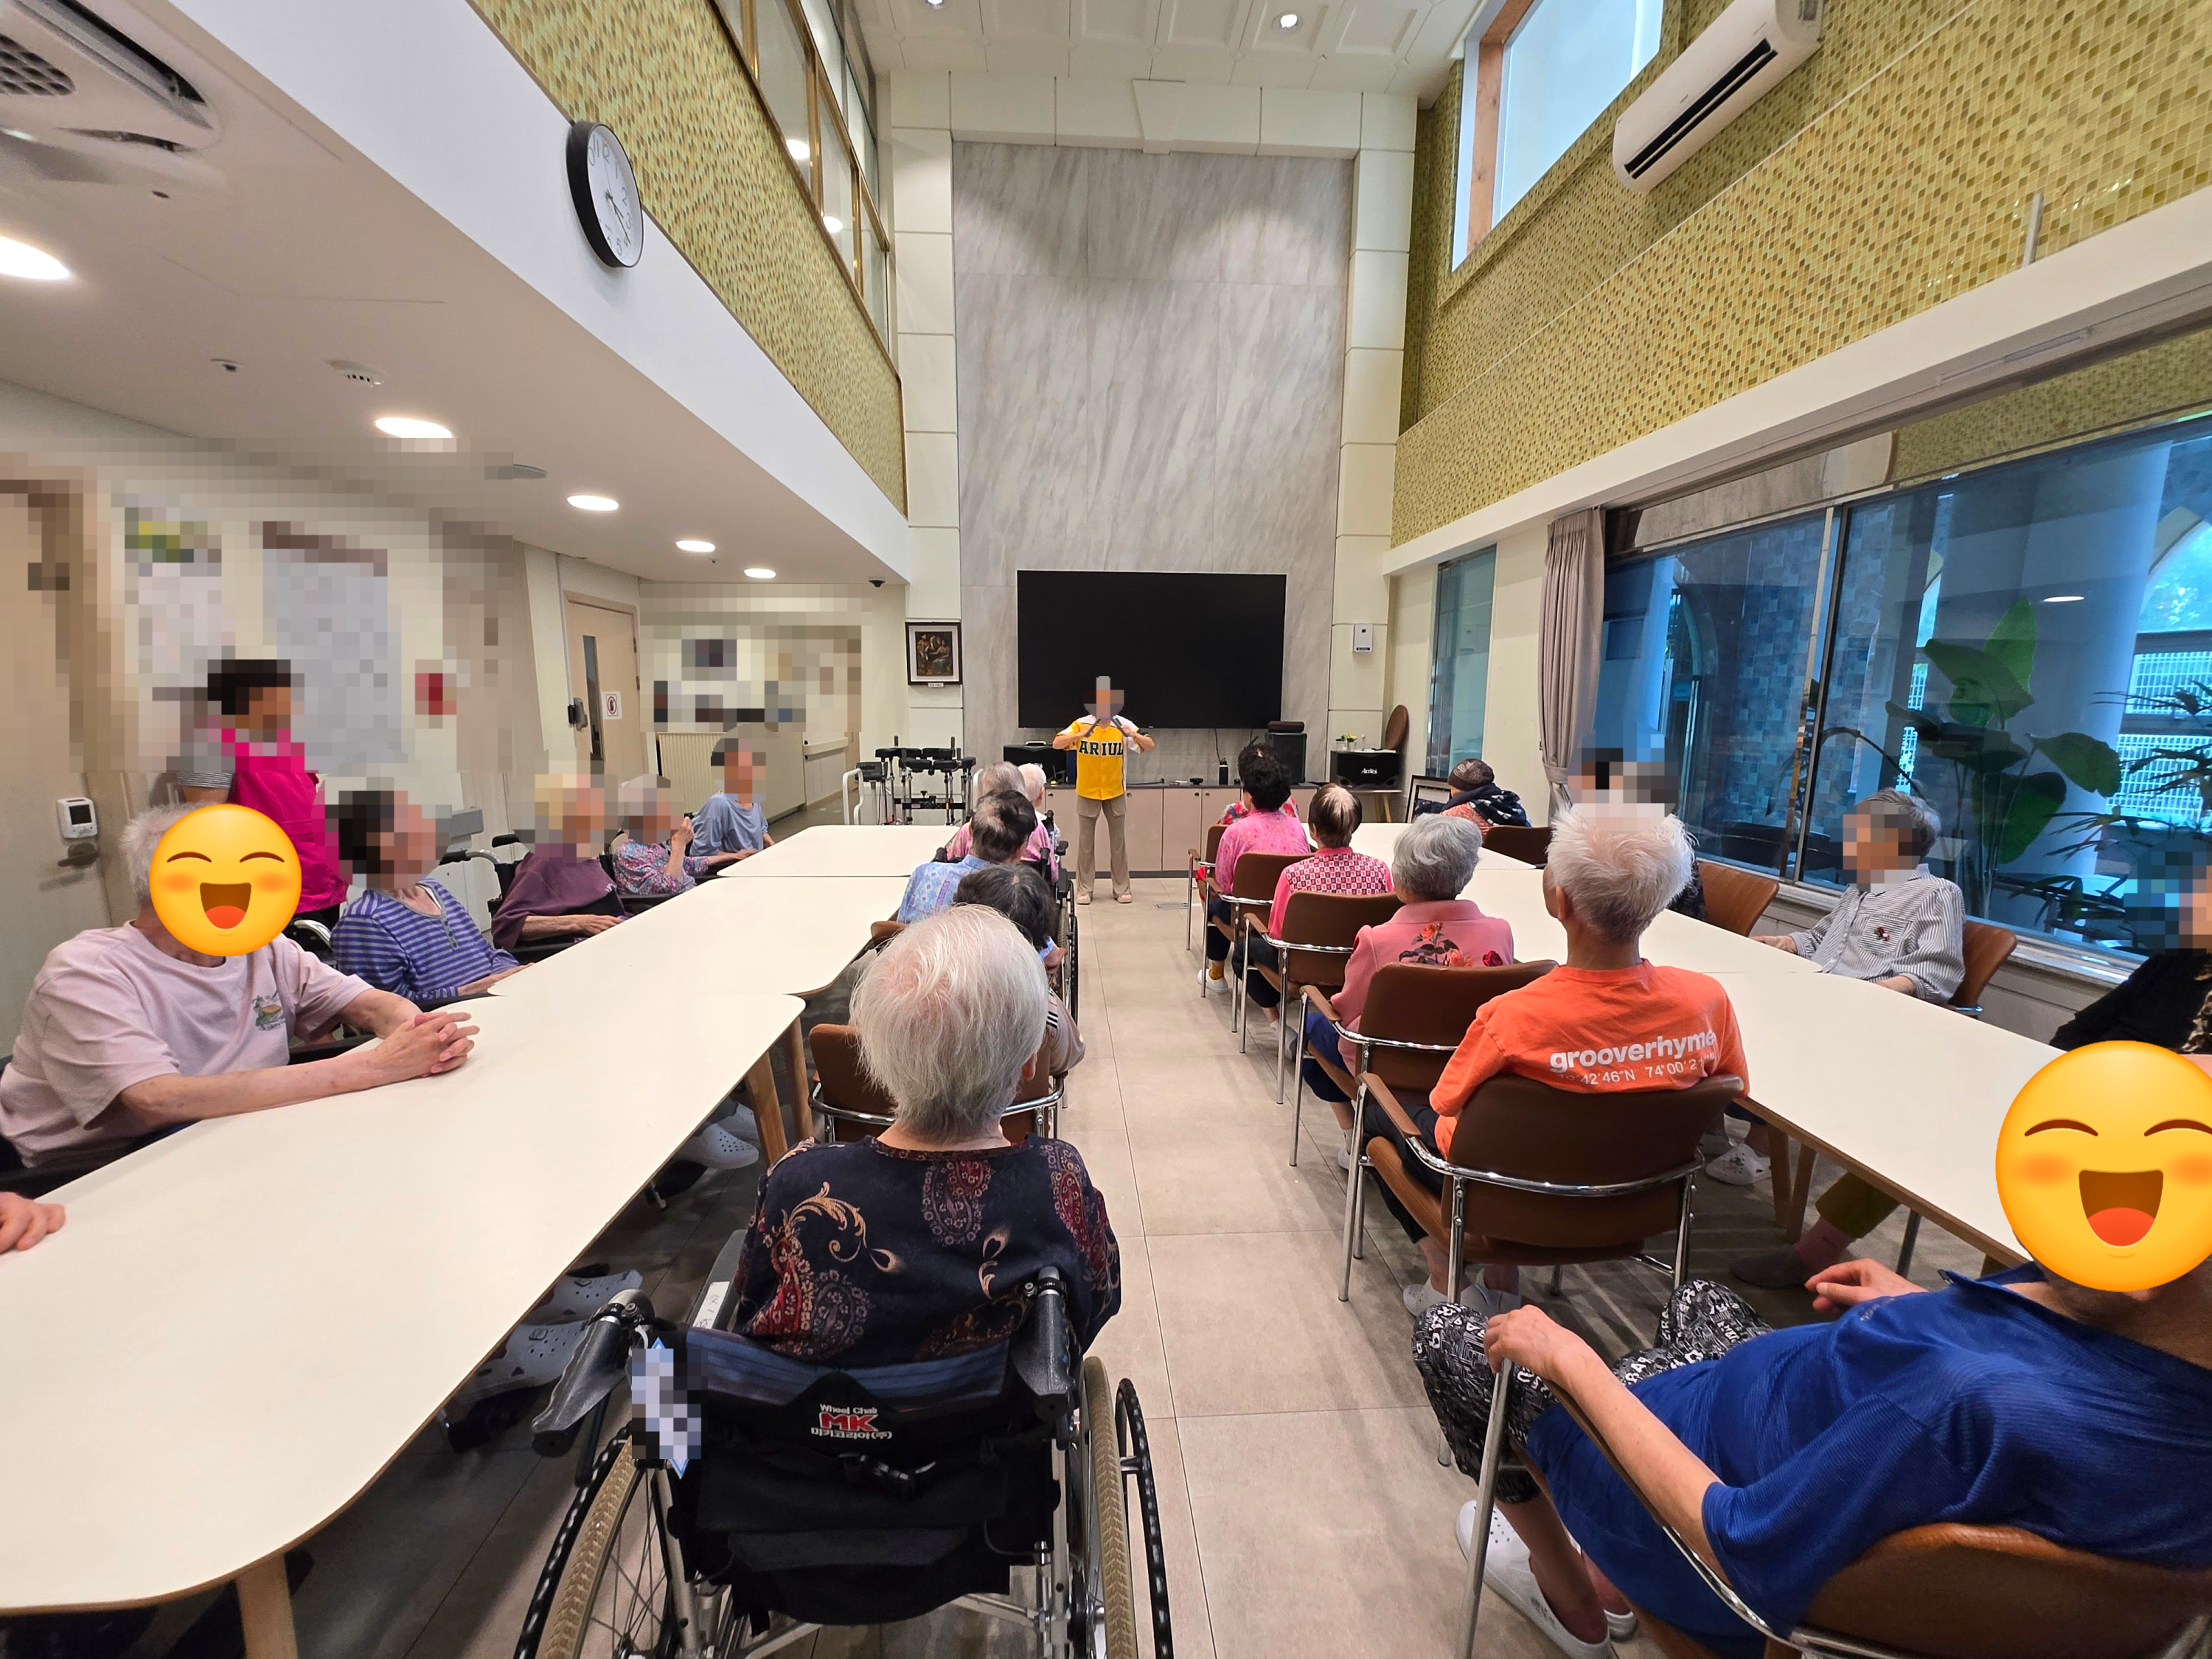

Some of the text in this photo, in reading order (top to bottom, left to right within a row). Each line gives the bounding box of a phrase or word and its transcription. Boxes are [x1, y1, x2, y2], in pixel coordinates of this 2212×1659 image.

[1550, 1029, 1716, 1074] grooverhyme
[820, 1403, 850, 1414] Wheel
[818, 1411, 879, 1432] MK
